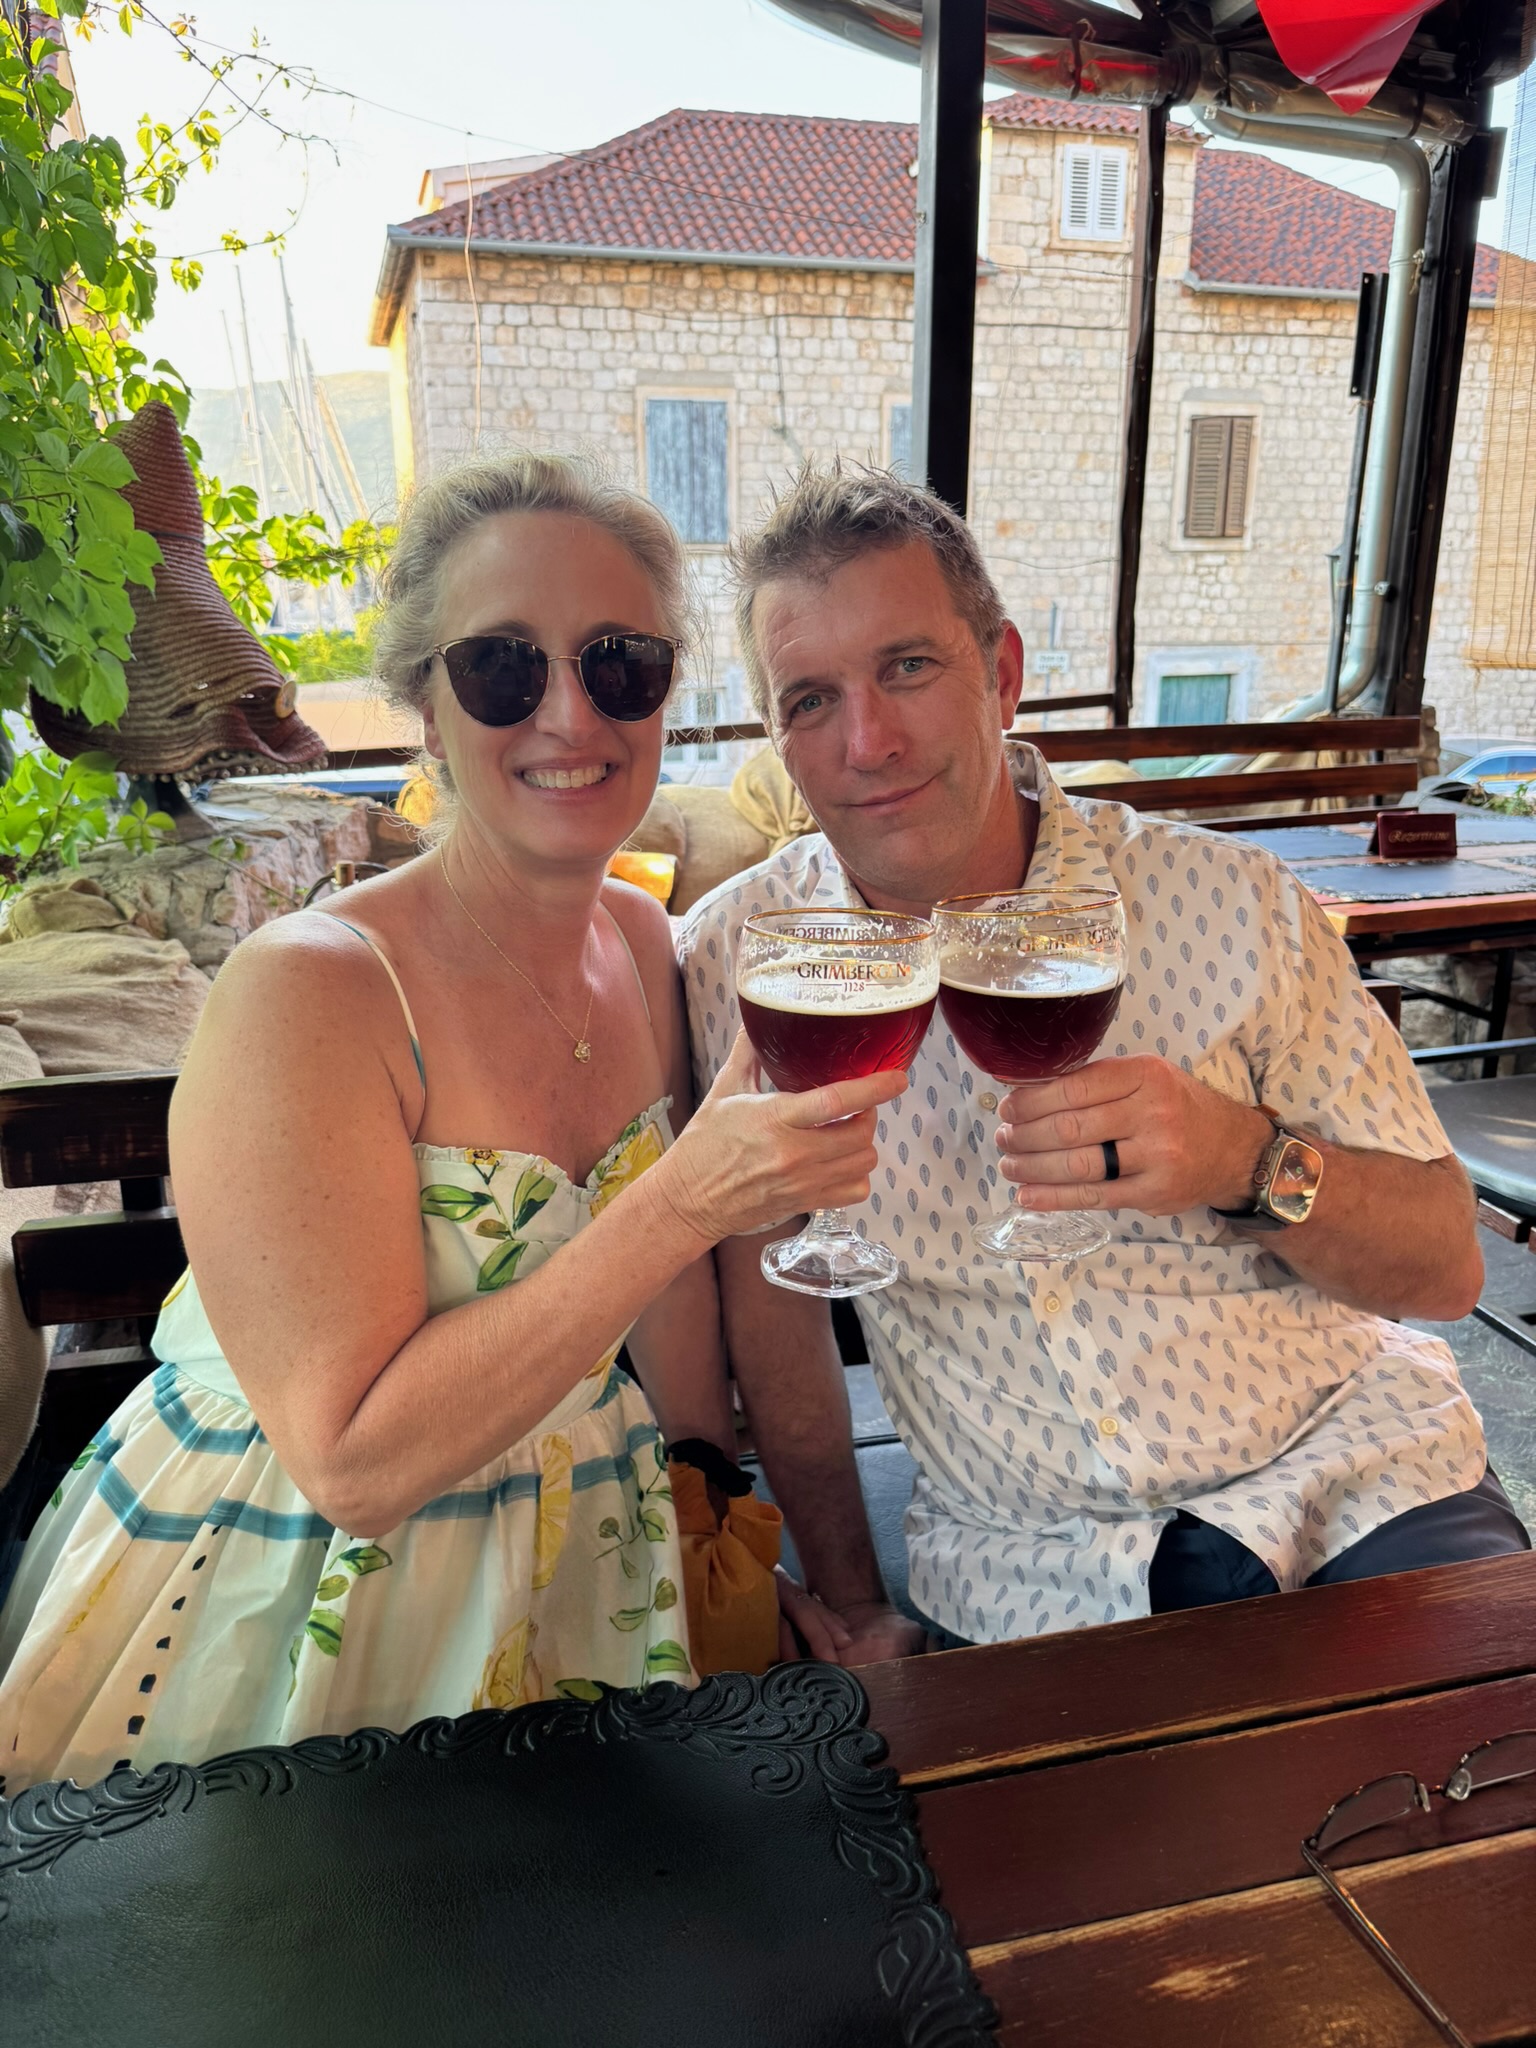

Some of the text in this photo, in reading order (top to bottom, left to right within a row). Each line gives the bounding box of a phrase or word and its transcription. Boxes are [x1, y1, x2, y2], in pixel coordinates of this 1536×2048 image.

[1016, 925, 1115, 952] GRIMBERGEN
[797, 961, 907, 980] GRIMBERGEN
[843, 982, 865, 992] 1128
